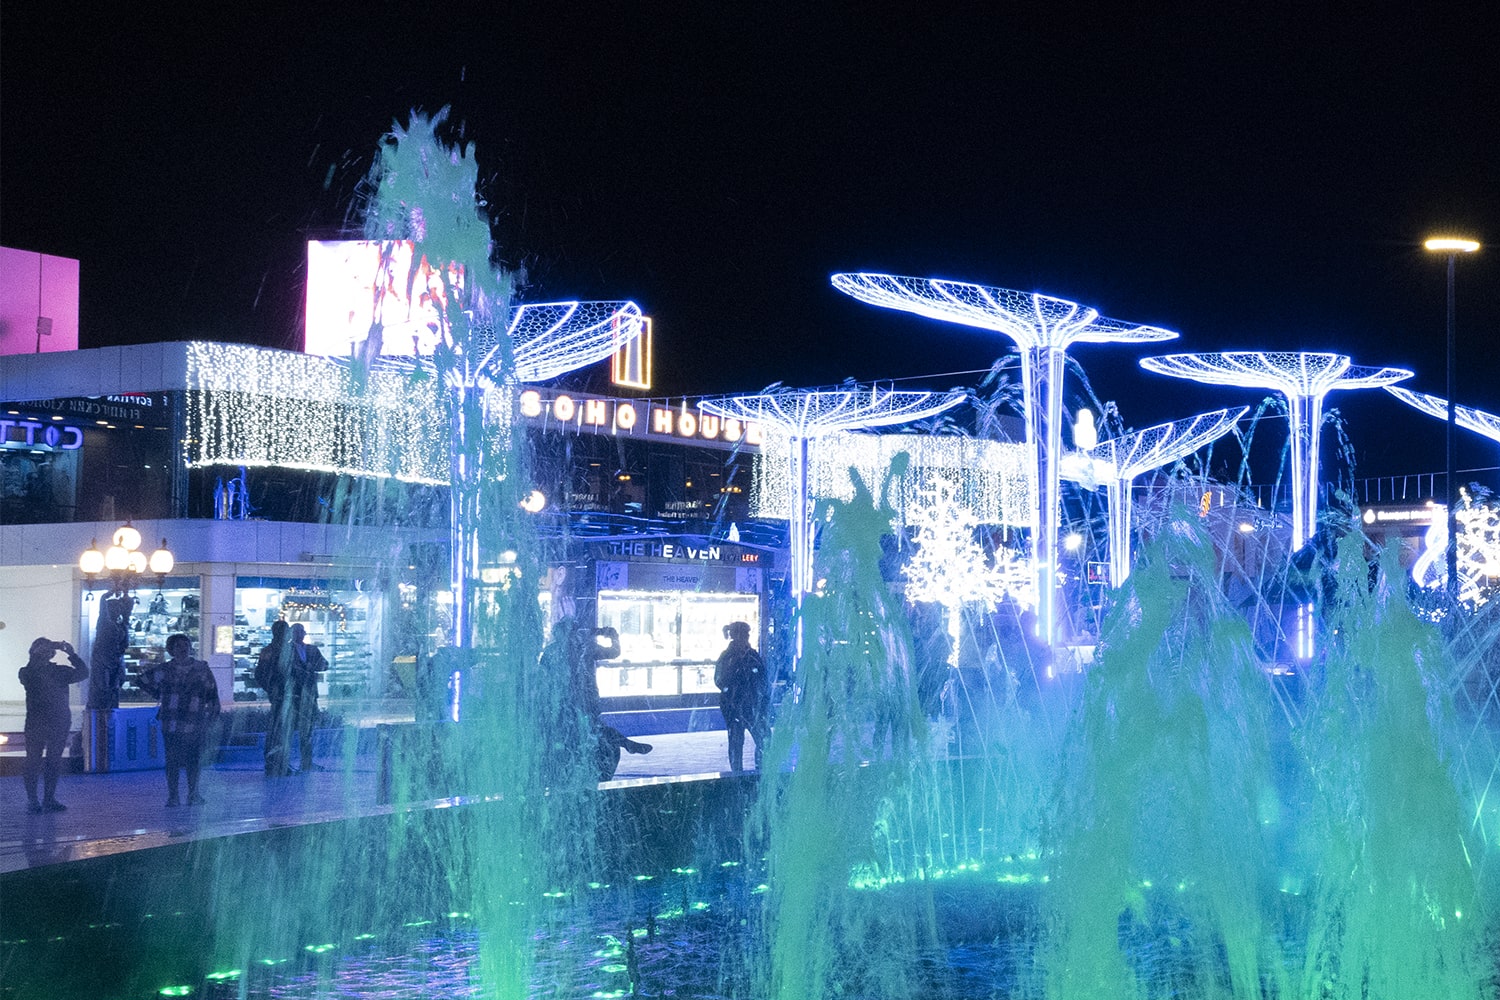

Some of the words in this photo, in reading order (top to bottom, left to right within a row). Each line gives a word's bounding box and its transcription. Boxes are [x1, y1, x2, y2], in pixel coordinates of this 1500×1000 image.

[519, 390, 637, 430] SOHO
[653, 408, 763, 445] HOUSE
[609, 541, 645, 556] THE
[651, 543, 721, 560] HEAVEN
[663, 575, 676, 583] THE
